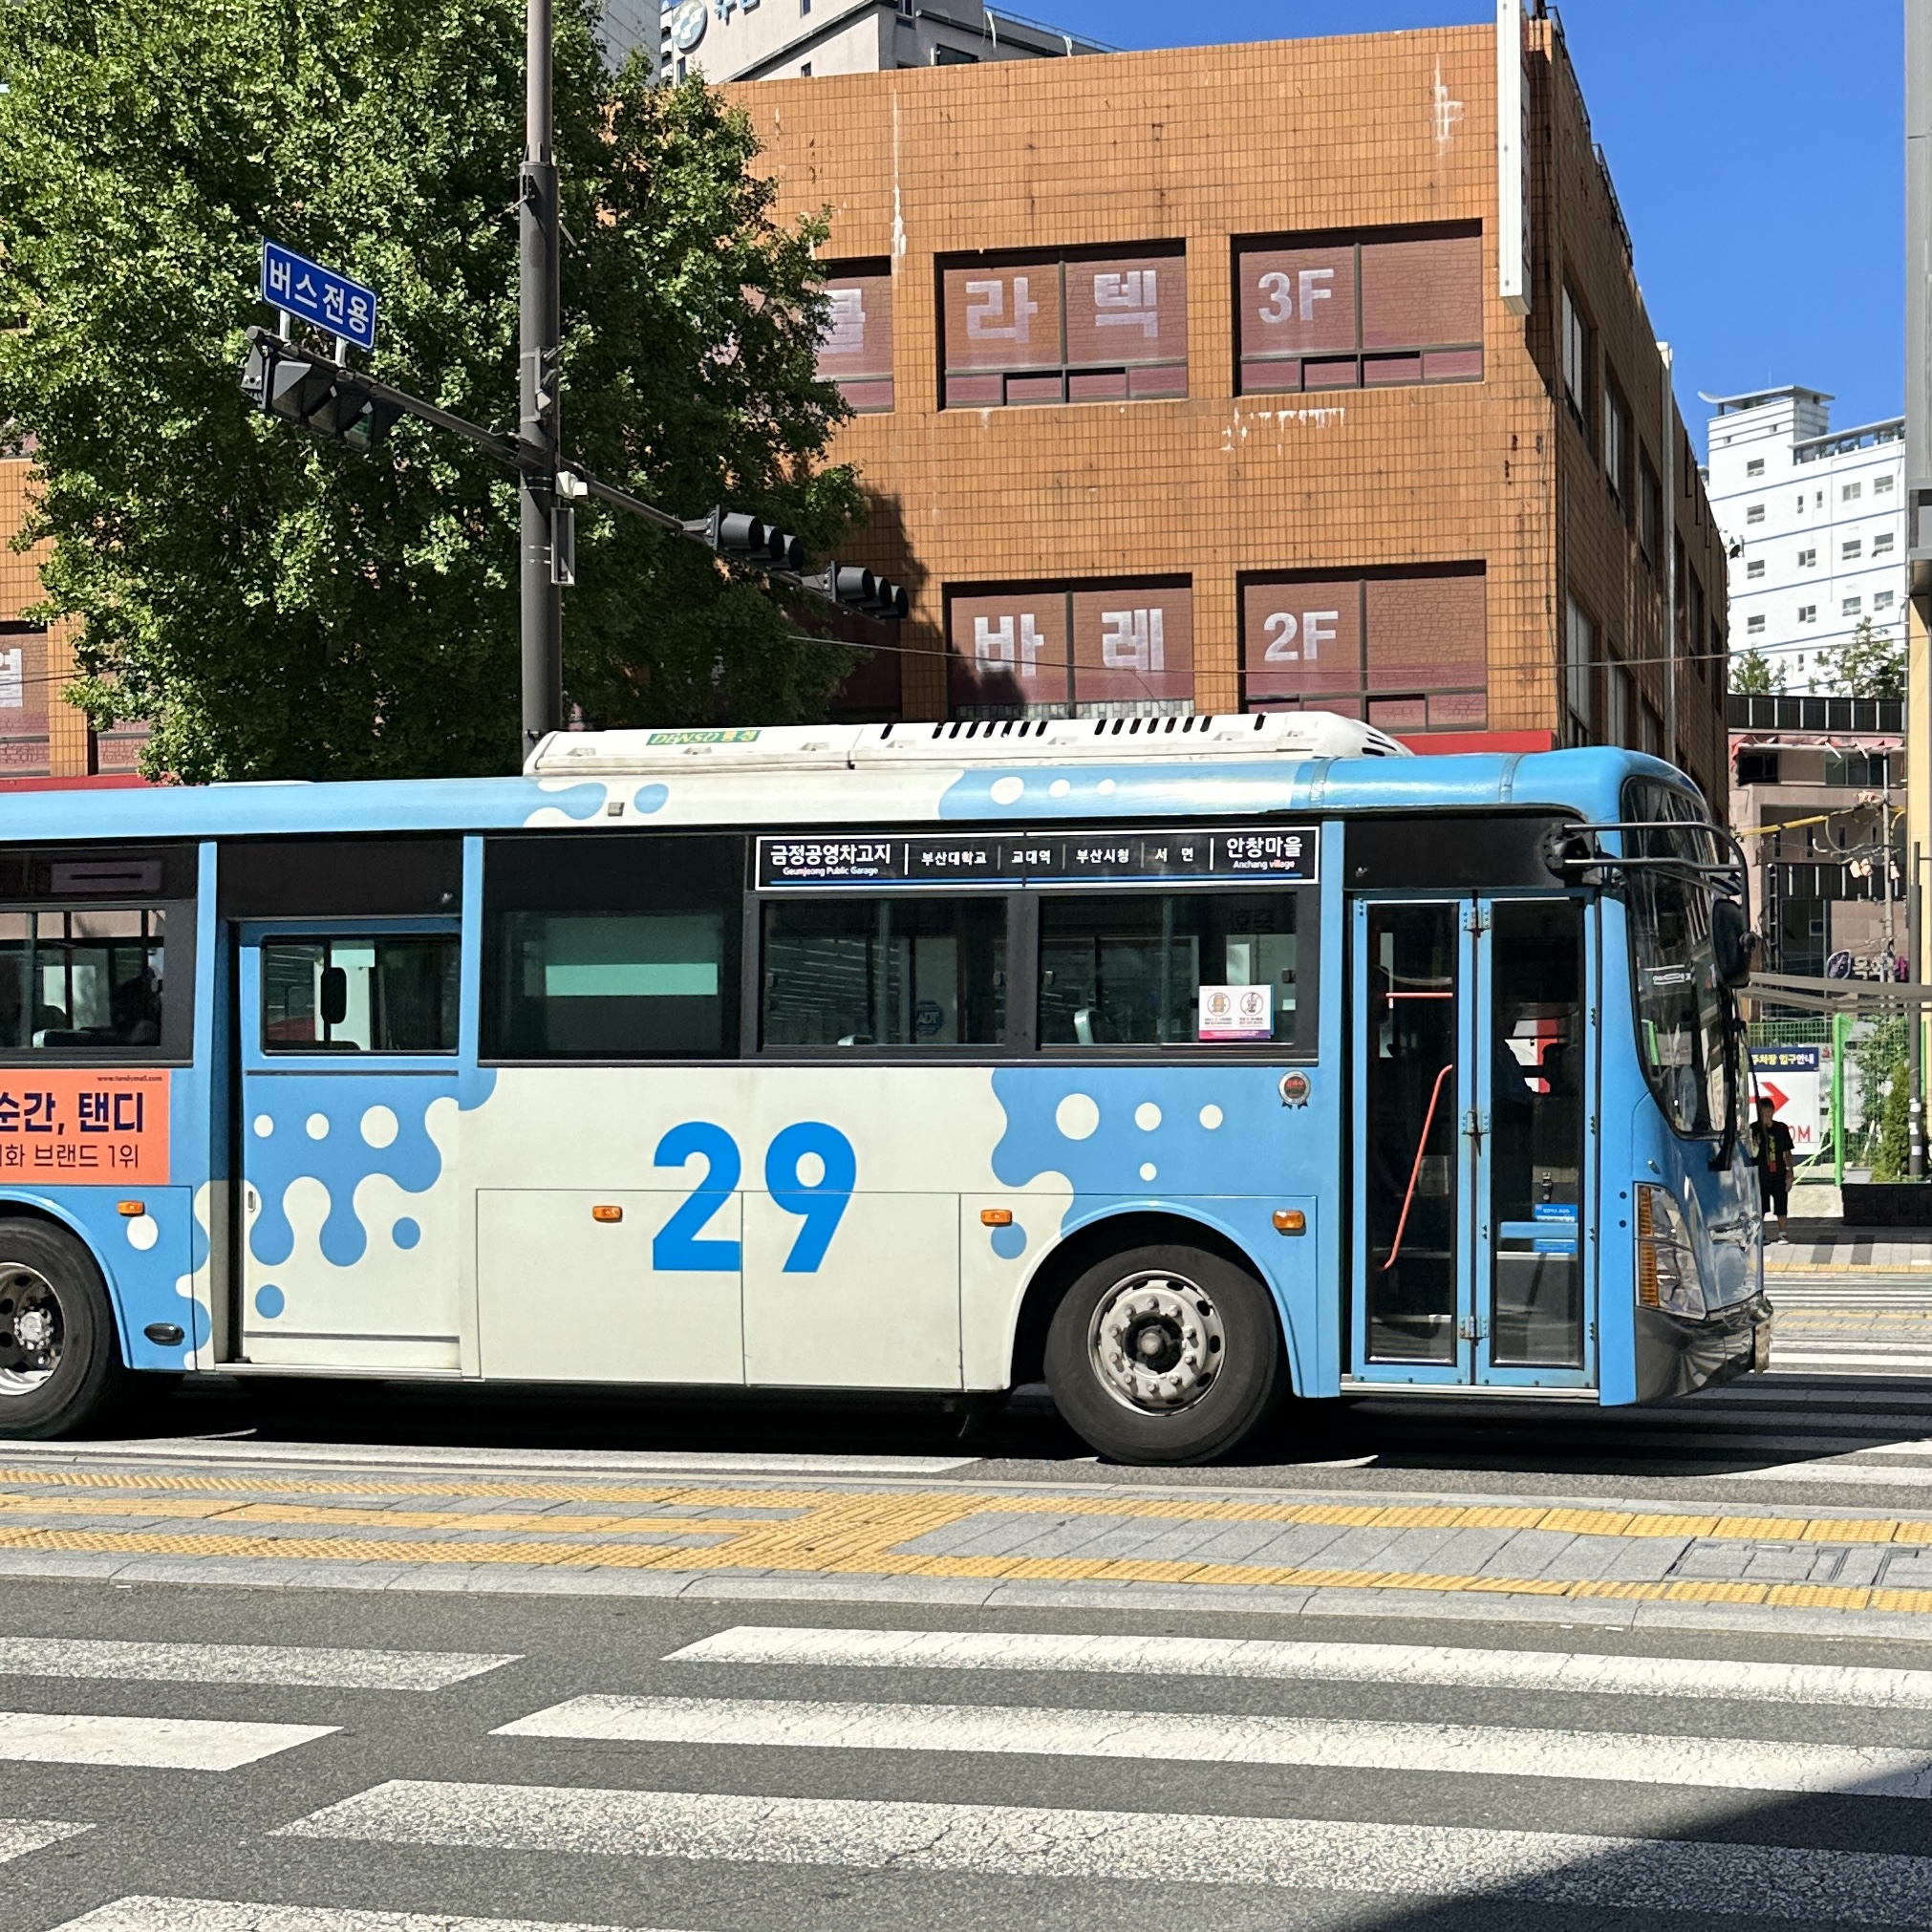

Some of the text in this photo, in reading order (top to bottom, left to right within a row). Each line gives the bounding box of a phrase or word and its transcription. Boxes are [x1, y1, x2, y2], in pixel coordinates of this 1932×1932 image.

[269, 258, 370, 334] 버스전용
[1257, 268, 1335, 324] 3F
[974, 608, 1339, 677] 바 레 2F
[652, 733, 719, 743] DENSO
[770, 843, 891, 866] 금정공영차고지
[921, 850, 987, 867] 부산대학교
[1011, 849, 1051, 865] 교대역
[1076, 848, 1129, 864] 부산시청
[1227, 836, 1303, 859] 안창마을
[1269, 858, 1296, 869] village
[826, 866, 848, 876] Public
[850, 866, 879, 876] Garage
[1779, 1053, 1814, 1065] 입구안내
[78, 1092, 143, 1133] 탠디
[0, 1144, 139, 1169] 화 브랜드 1위
[653, 1121, 856, 1273] 29
